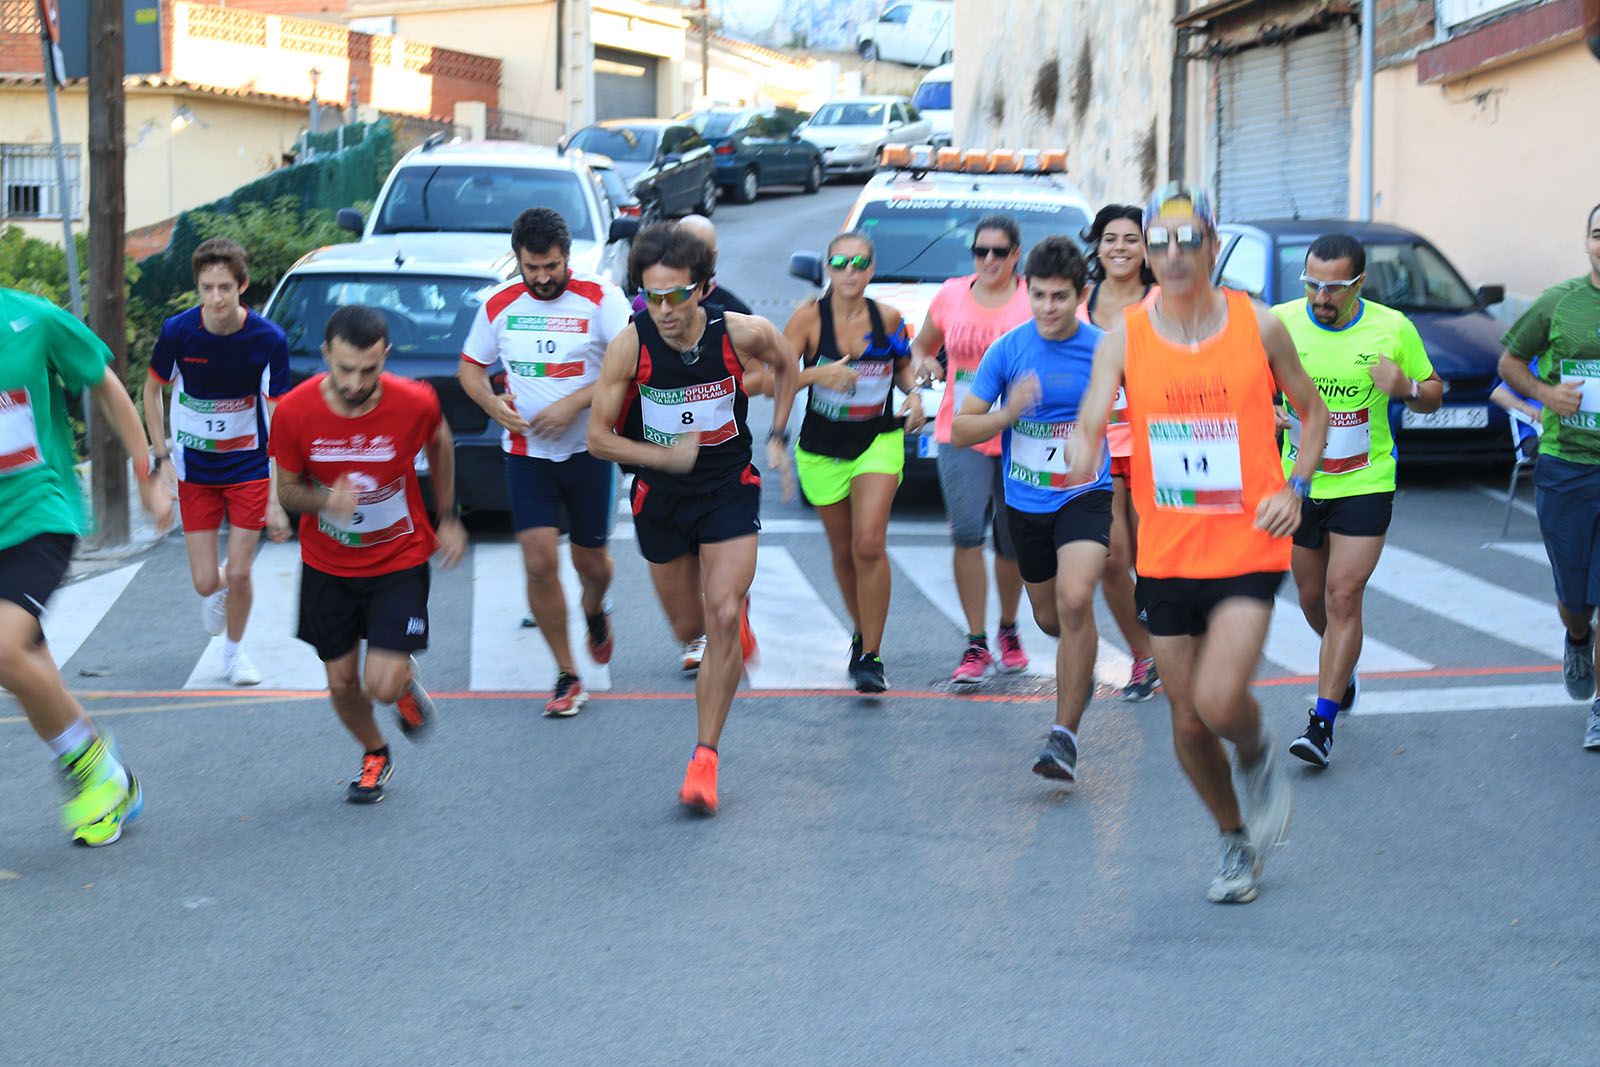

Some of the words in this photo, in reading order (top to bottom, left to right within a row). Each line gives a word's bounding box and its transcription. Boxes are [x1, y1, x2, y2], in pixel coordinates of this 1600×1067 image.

[543, 317, 578, 326] POPULAR
[536, 339, 557, 354] 10
[1576, 362, 1600, 371] CURS
[649, 389, 678, 399] CURSA
[680, 383, 722, 397] POPULAR
[664, 396, 689, 404] MAJOR
[690, 394, 701, 402] LES
[702, 389, 728, 399] PLANES
[205, 419, 226, 432] 13
[681, 411, 695, 425] 8
[1338, 418, 1362, 427] PLANES
[178, 433, 207, 450] 2016
[646, 429, 679, 447] 2016
[1045, 447, 1057, 462] 7
[1011, 463, 1041, 487] 2016
